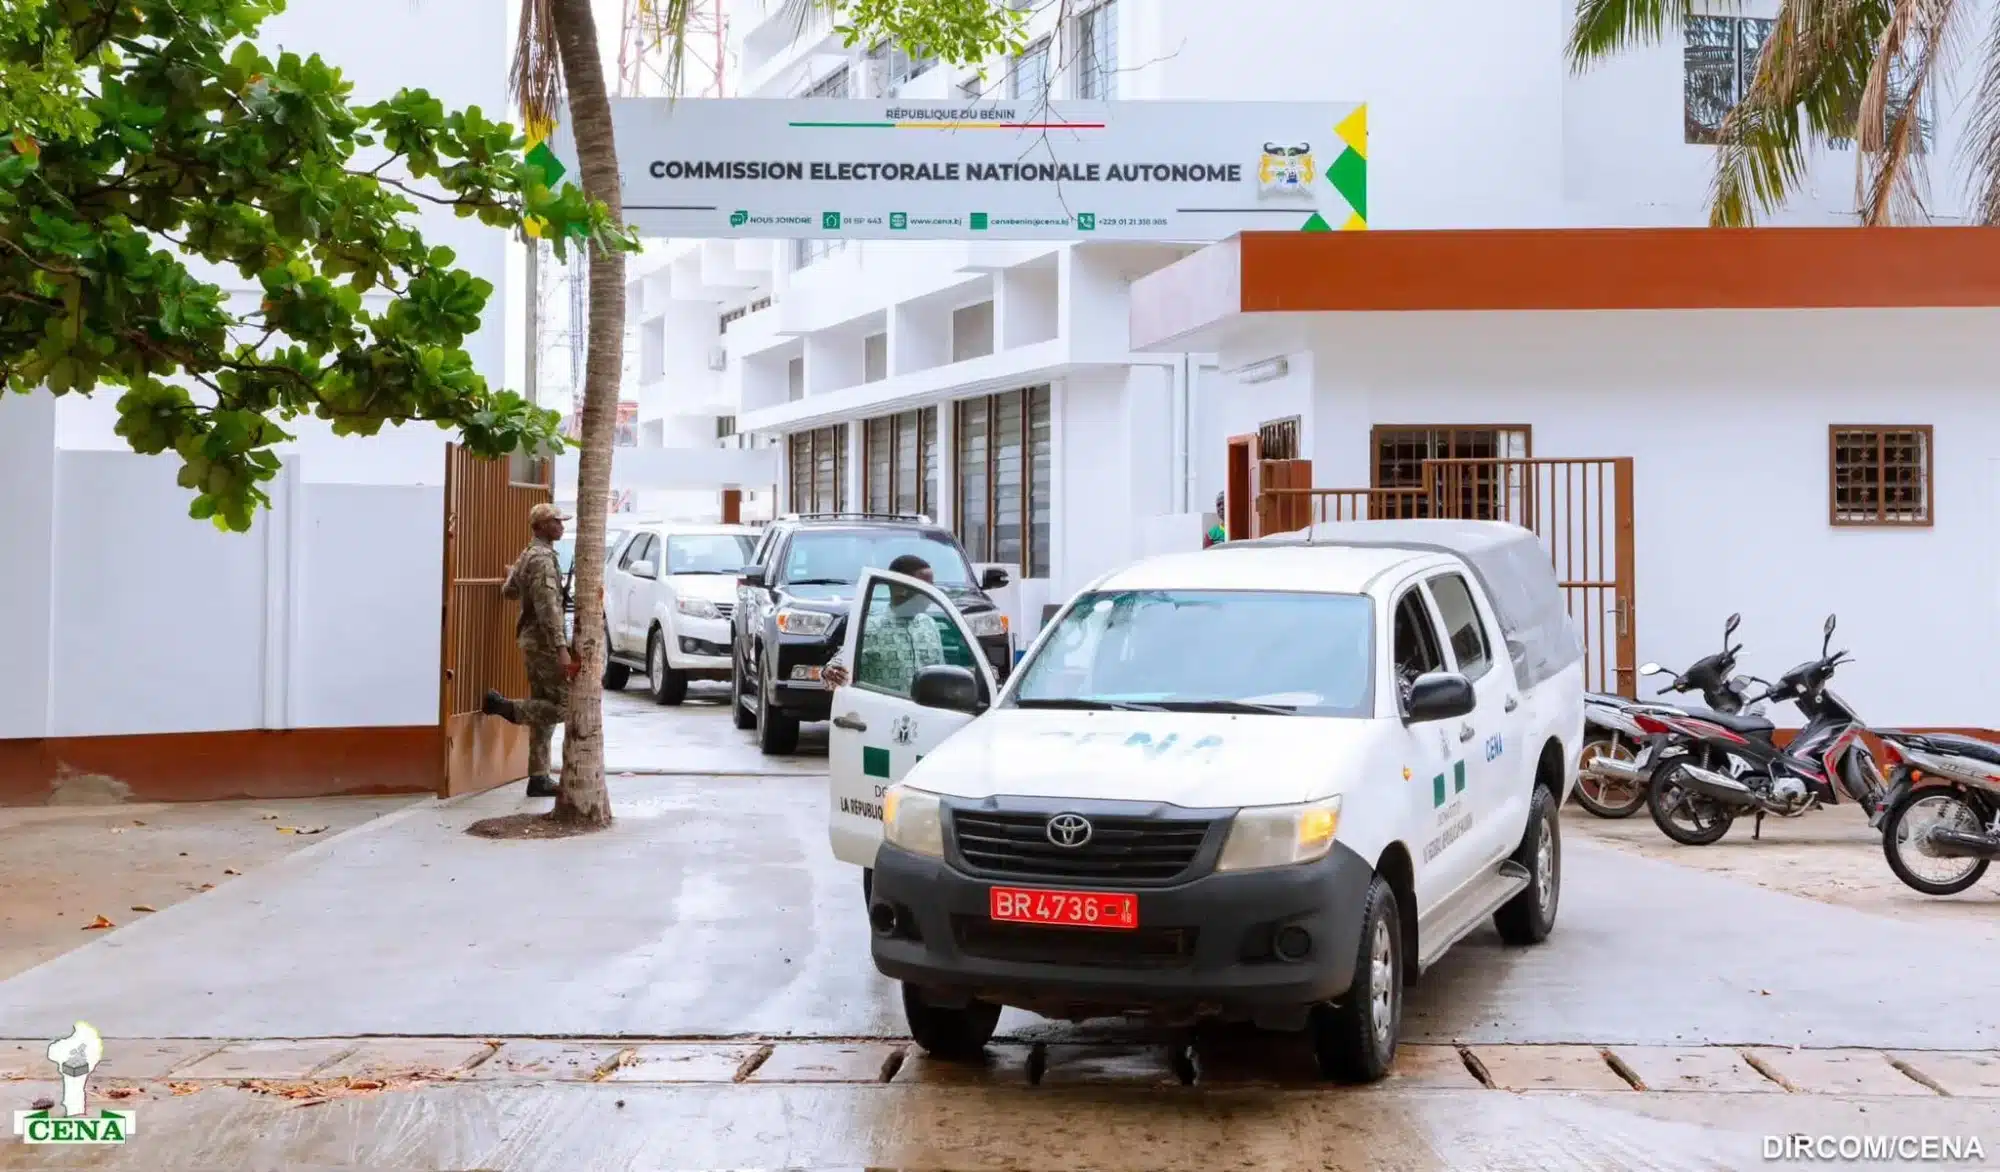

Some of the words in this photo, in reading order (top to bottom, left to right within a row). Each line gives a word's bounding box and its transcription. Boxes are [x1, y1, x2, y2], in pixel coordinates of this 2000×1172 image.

[886, 107, 957, 120] RÉPUBLIQUE
[960, 108, 978, 120] DU
[980, 107, 1016, 120] BÉNIN
[649, 160, 803, 180] COMMISSION
[810, 162, 960, 181] ELECTORALE
[966, 162, 1100, 182] NATIONALE
[1106, 164, 1242, 182] AUTONOME
[749, 216, 774, 225] NOUS
[776, 216, 812, 225] JOINDRE
[840, 796, 849, 813] LA
[850, 798, 884, 822] RÉPUBLIQ
[996, 891, 1032, 918] BR
[1036, 895, 1099, 922] 4736
